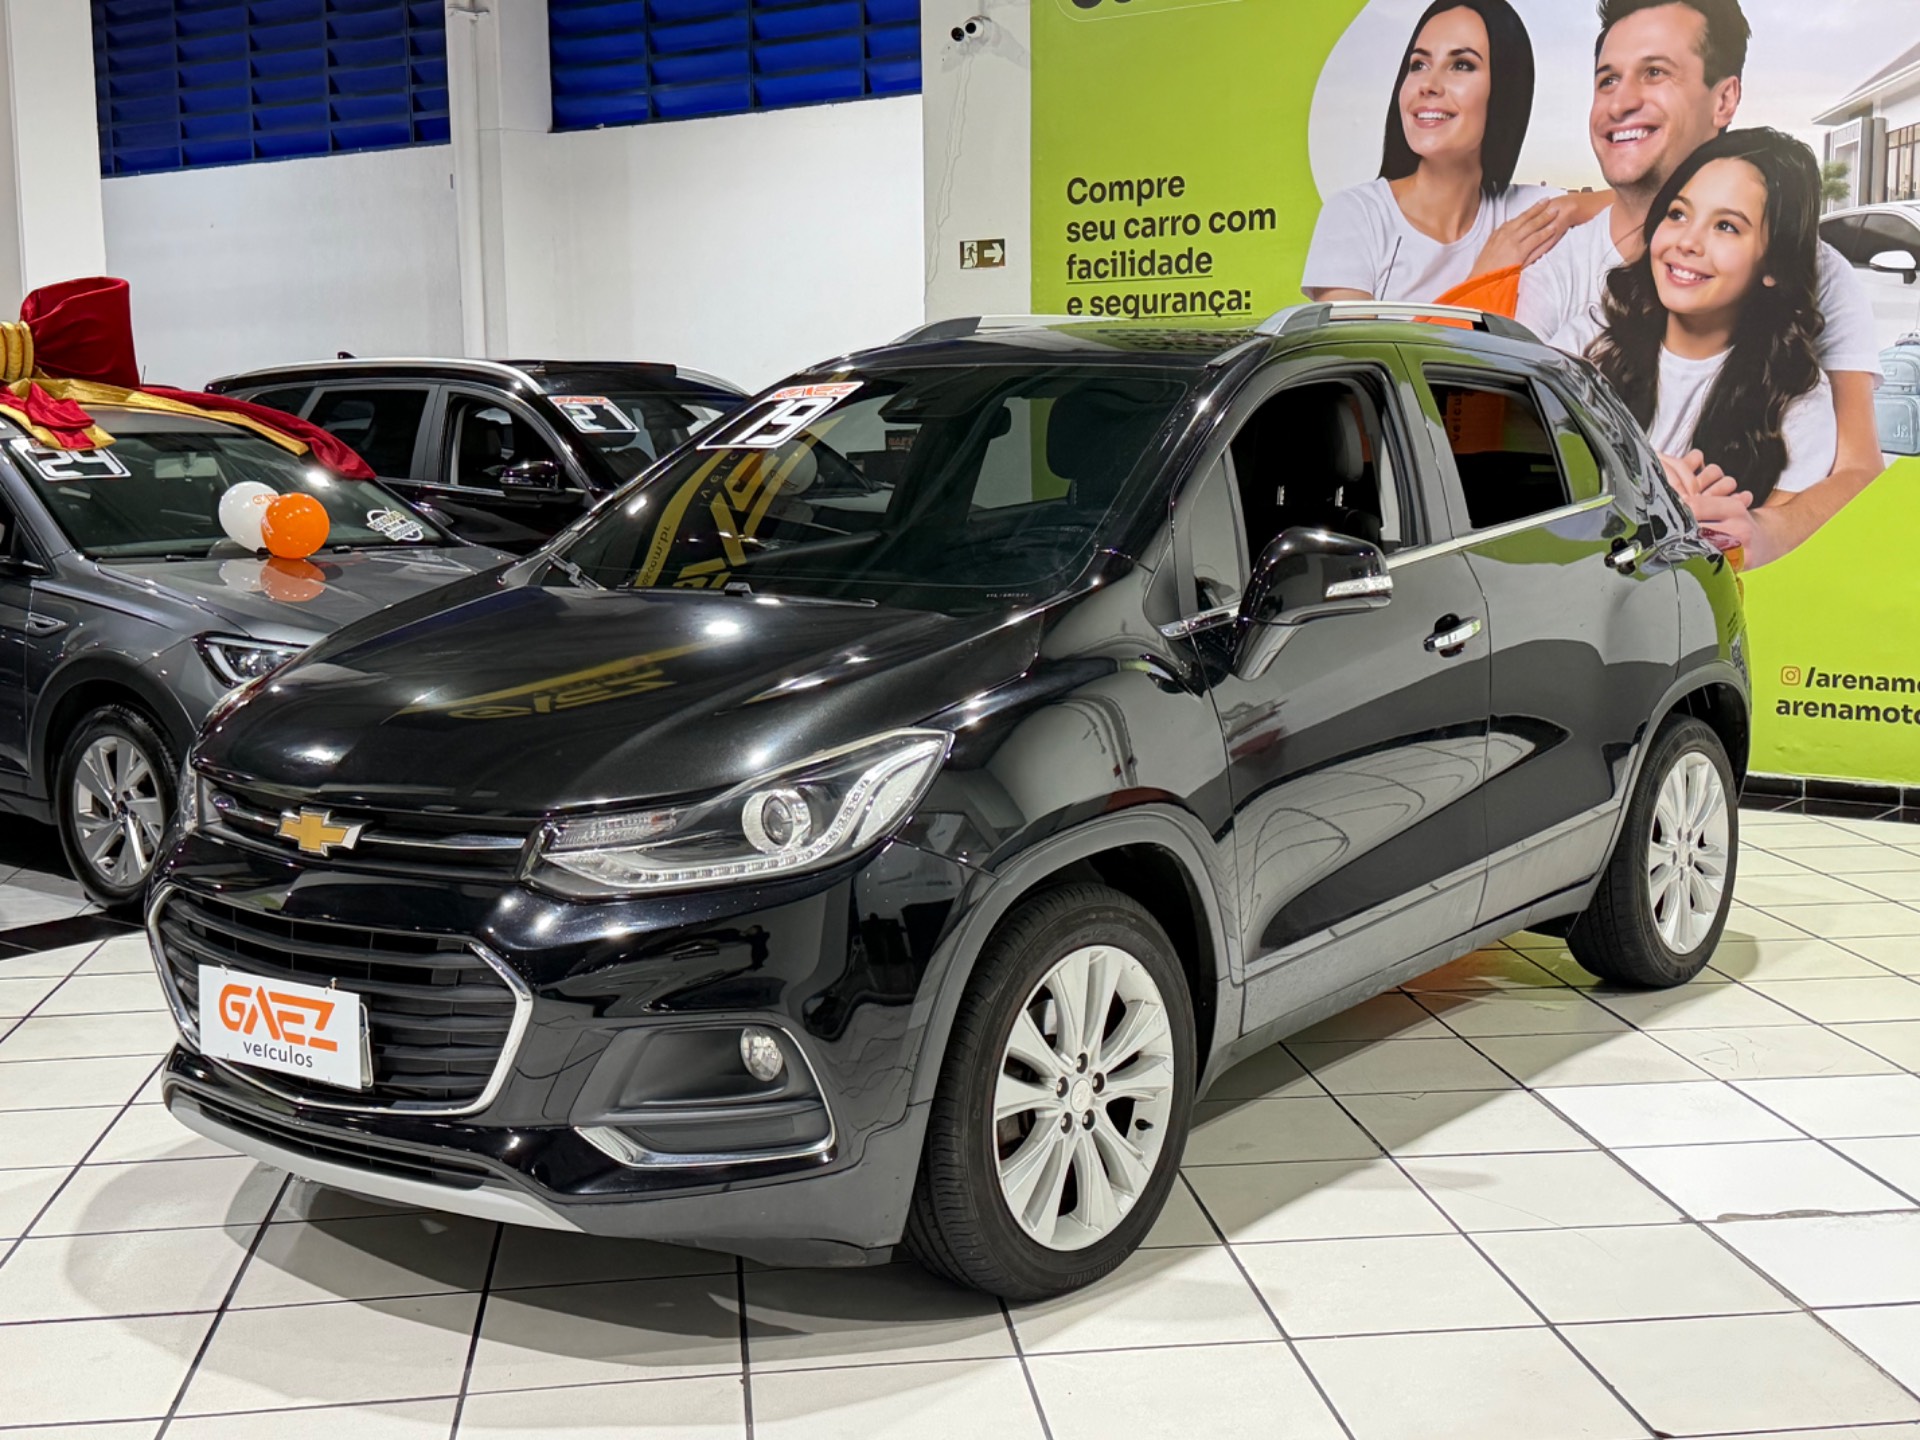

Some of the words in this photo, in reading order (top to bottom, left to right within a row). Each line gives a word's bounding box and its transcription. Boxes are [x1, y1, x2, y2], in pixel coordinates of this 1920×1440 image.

[1067, 176, 1185, 207] Compre
[1066, 219, 1116, 243] seu
[1124, 213, 1201, 239] carro
[1208, 207, 1276, 234] com
[1066, 247, 1213, 280] facilidade
[1067, 296, 1083, 315] e
[1090, 288, 1252, 318] segurança:
[562, 404, 634, 430] 21
[729, 398, 834, 445] 19
[28, 448, 123, 477] 24
[1805, 666, 1920, 694] /arenam
[219, 983, 338, 1053] GAEZ
[243, 1041, 314, 1069] veículos
